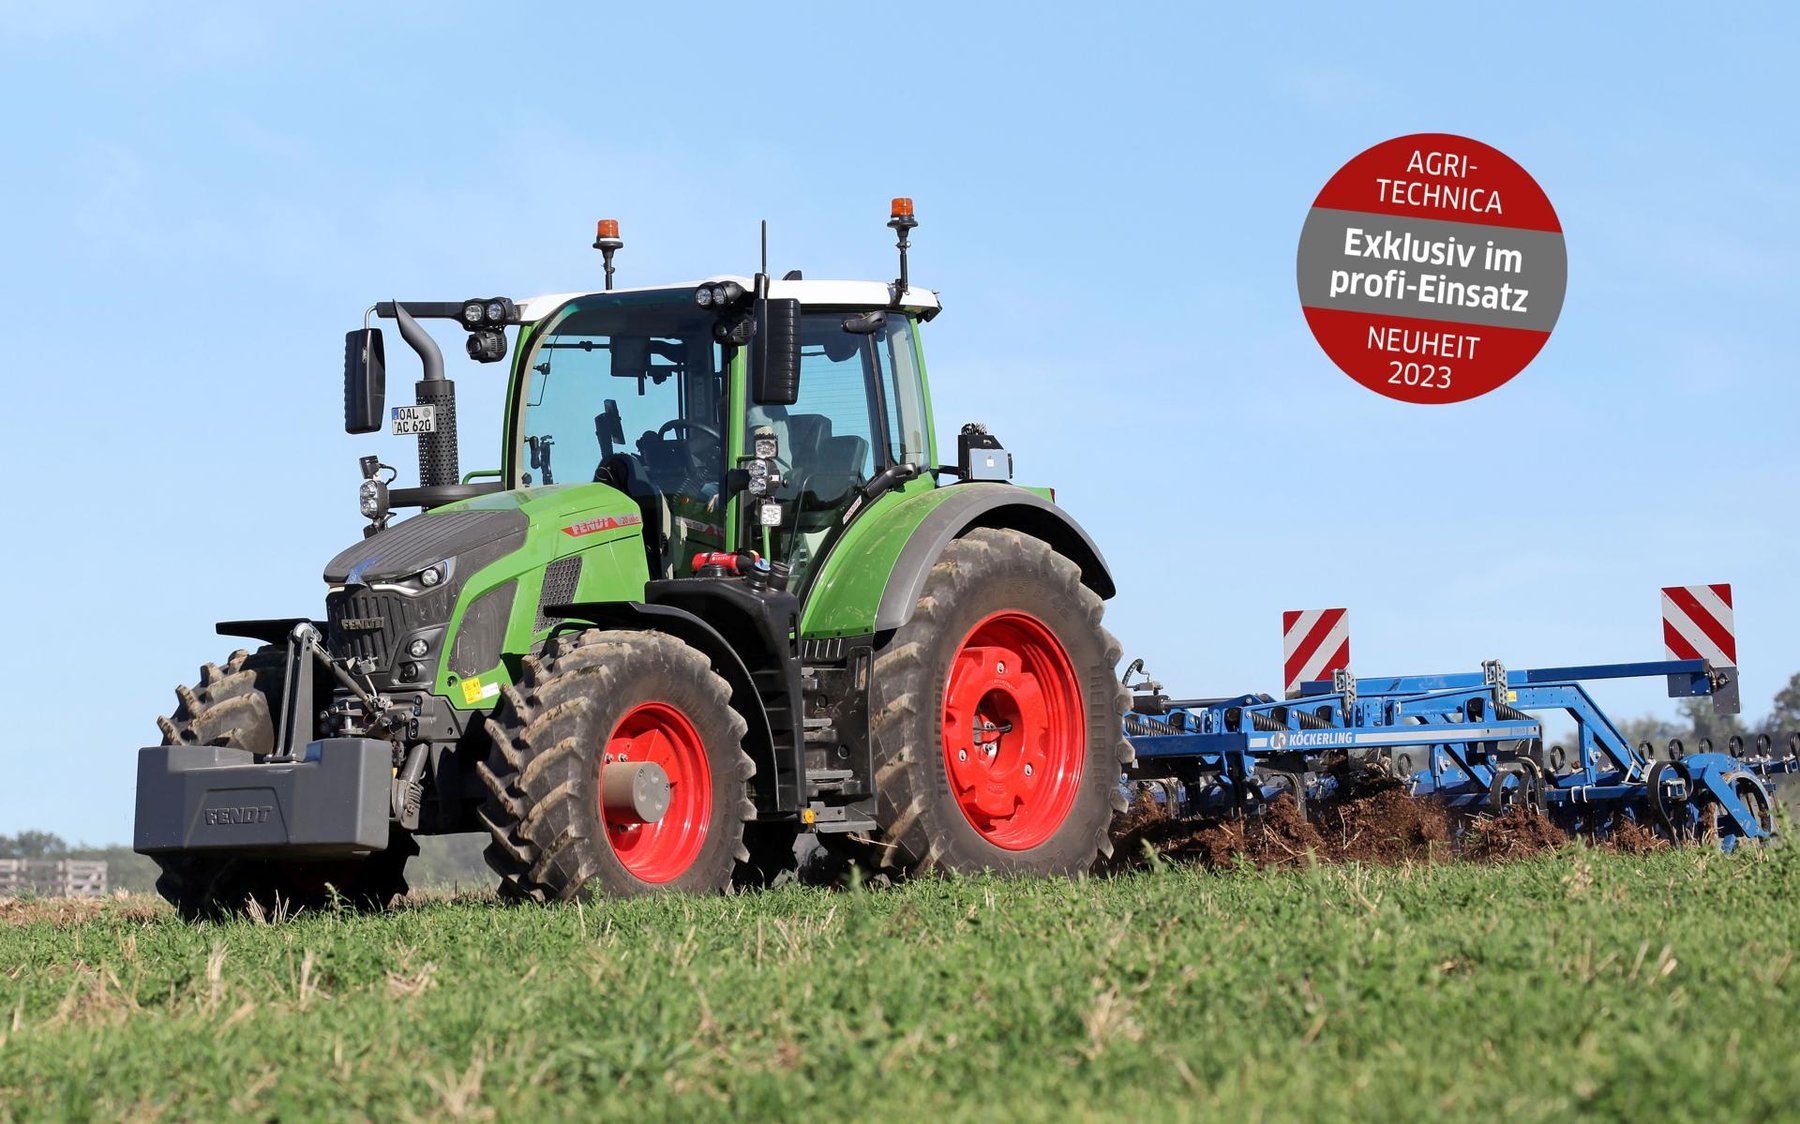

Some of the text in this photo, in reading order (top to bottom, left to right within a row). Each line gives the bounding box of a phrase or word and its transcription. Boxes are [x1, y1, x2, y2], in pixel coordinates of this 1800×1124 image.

[399, 408, 419, 420] OAL
[396, 419, 431, 433] AC 620
[571, 517, 609, 534] FENDT
[1289, 731, 1353, 746] KÖCKERLING
[205, 806, 273, 825] FENDT
